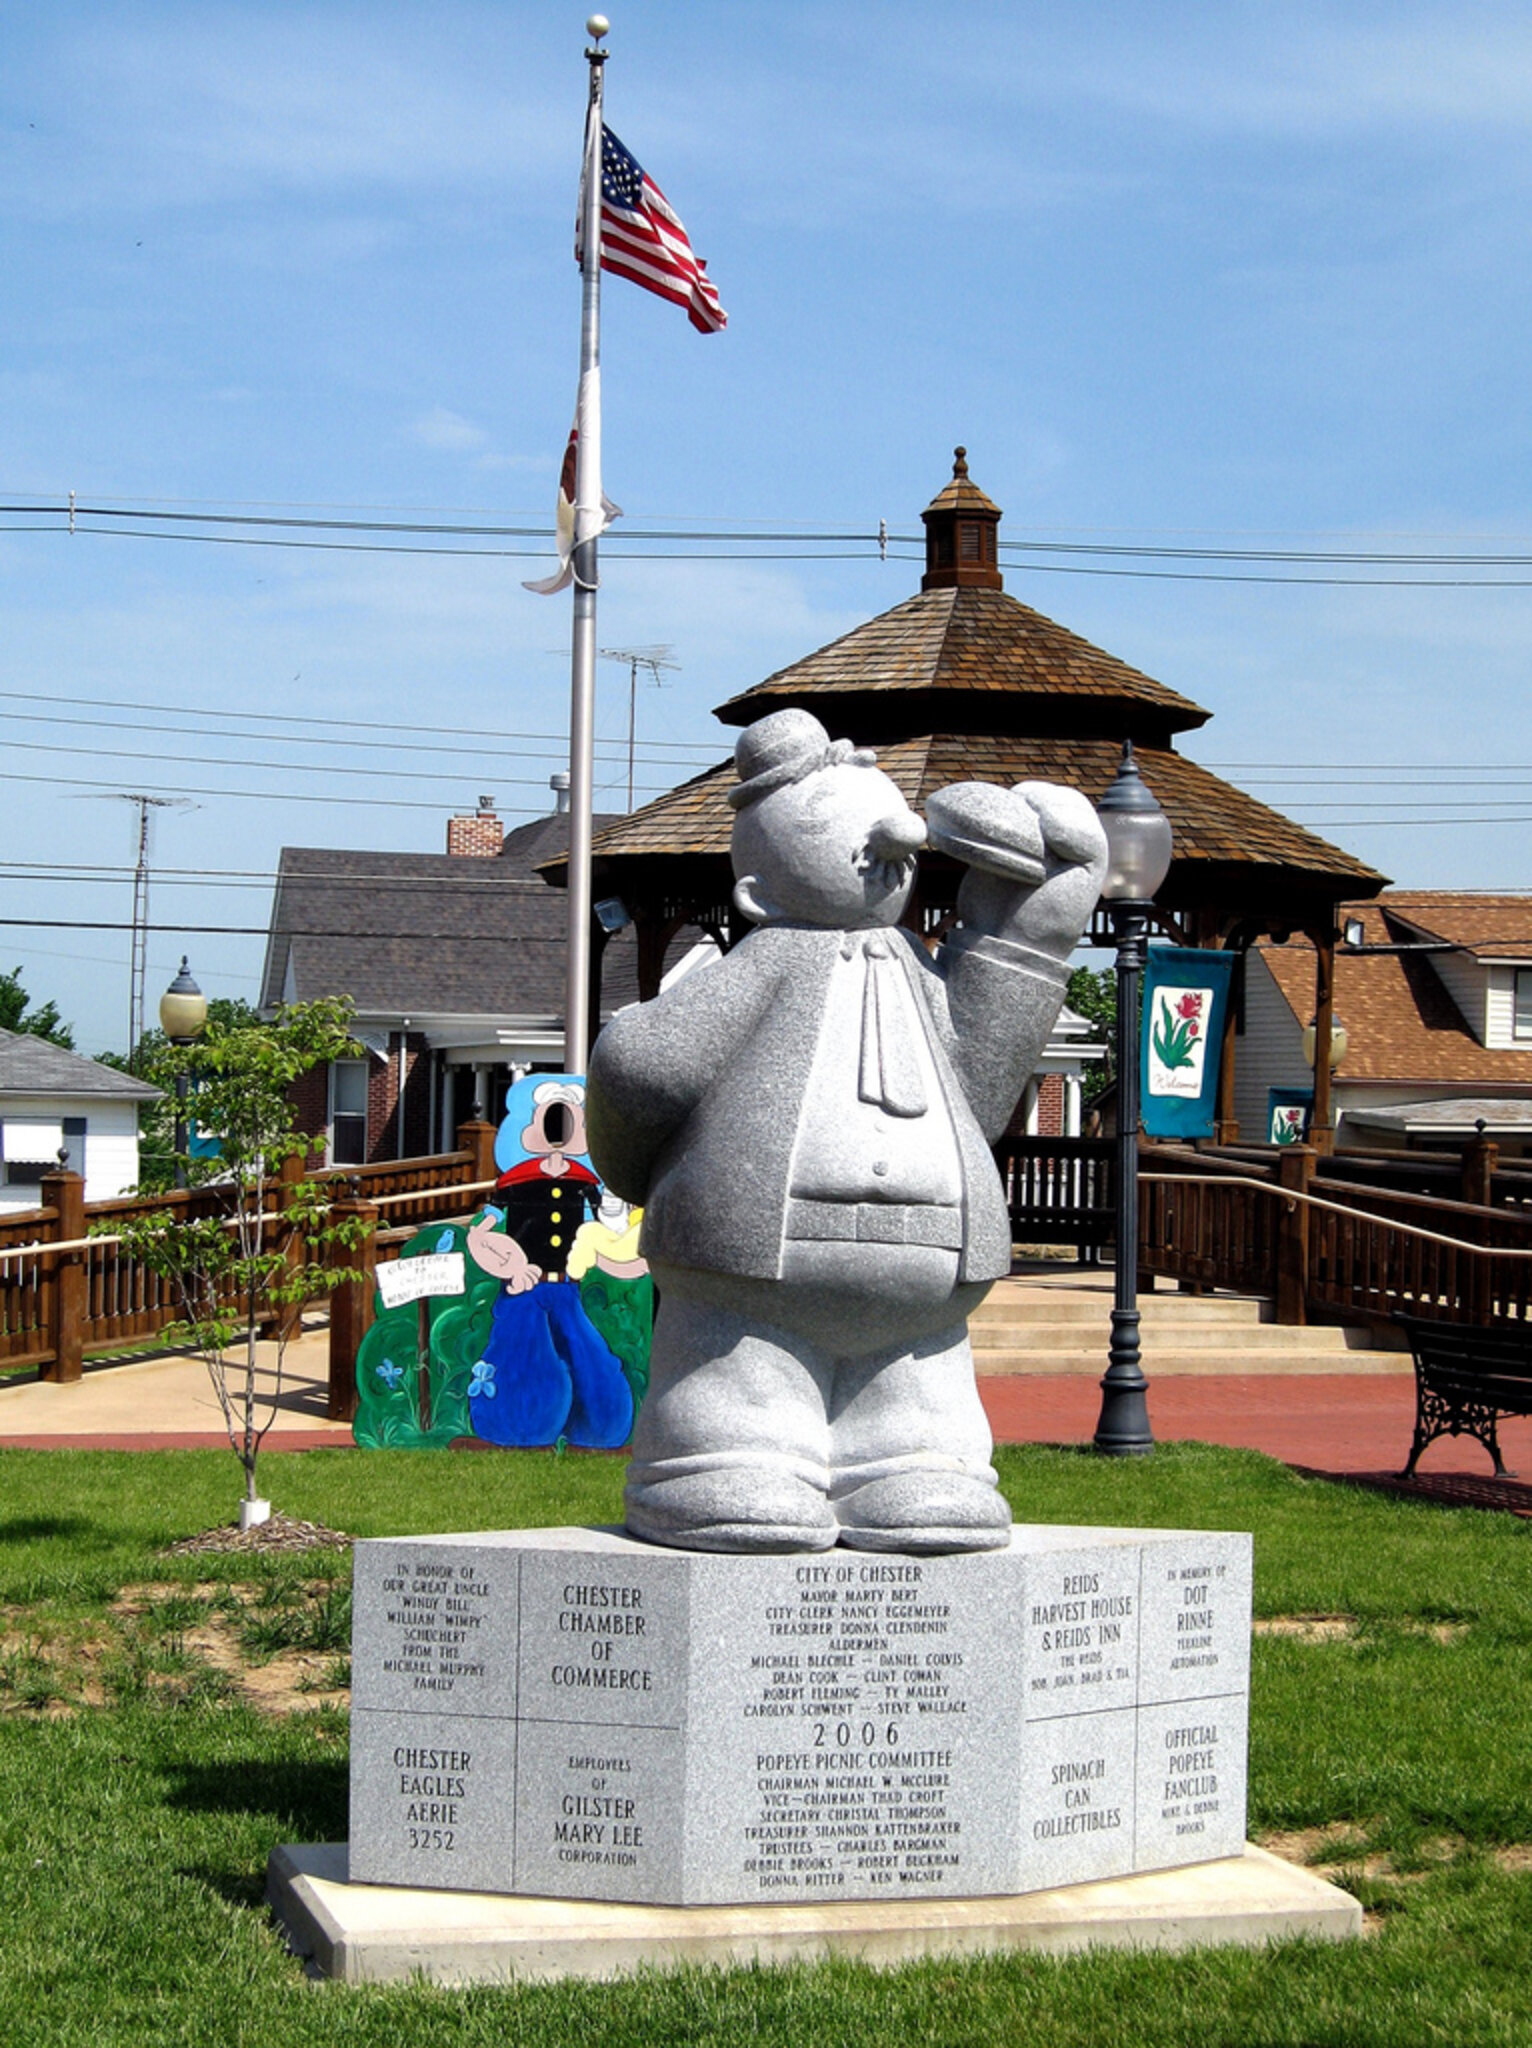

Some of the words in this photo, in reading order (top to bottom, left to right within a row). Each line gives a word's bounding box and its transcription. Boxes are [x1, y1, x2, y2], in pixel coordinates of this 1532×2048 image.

[396, 1564, 409, 1577] IN
[416, 1565, 454, 1579] HONOR
[460, 1567, 475, 1580] OF
[796, 1567, 831, 1583] CITY
[836, 1567, 854, 1582] OF
[860, 1566, 924, 1582] CHESTER
[1167, 1569, 1177, 1580] IN
[1180, 1567, 1212, 1579] MEMORY
[1216, 1564, 1226, 1577] OF
[383, 1579, 405, 1592] OUR
[412, 1580, 448, 1594] GREAT
[454, 1583, 489, 1597] UNCLE
[563, 1585, 644, 1608] CHESTER
[801, 1590, 838, 1602] MAYOR
[846, 1589, 885, 1601] MARTY
[891, 1589, 919, 1601] BERT
[1183, 1585, 1208, 1605] DOT
[387, 1611, 436, 1626] WILLIAM
[765, 1607, 793, 1620] CITY
[800, 1606, 834, 1619] CLERK
[841, 1605, 879, 1619] NANCY
[886, 1604, 951, 1618] EGGEMEYER
[1032, 1601, 1088, 1625] HARVEST
[1091, 1596, 1133, 1619] HOUSE
[559, 1611, 646, 1636] CHAMBER
[769, 1623, 834, 1636] TREASURER
[841, 1622, 880, 1635] DONNA
[1177, 1609, 1215, 1632] RINNE
[828, 1638, 890, 1651] ALDERMEN
[1042, 1631, 1052, 1652] &
[1099, 1623, 1122, 1646] INN
[402, 1644, 433, 1658] FROM
[440, 1646, 460, 1659] THE
[591, 1640, 614, 1661] OF
[383, 1660, 432, 1674] MICHAEL
[440, 1662, 485, 1677] MURPHY
[751, 1656, 801, 1669] MICHAEL
[879, 1654, 920, 1667] DANIEL
[1170, 1653, 1219, 1670] AUTOMATION
[413, 1677, 455, 1691] FAMILY
[551, 1665, 652, 1691] COMMERCE
[773, 1671, 803, 1684] DEAN
[809, 1671, 839, 1684] COOK
[864, 1670, 897, 1683] CLINT
[763, 1688, 805, 1701] ROBERT
[811, 1687, 861, 1700] FLEMING
[885, 1686, 900, 1699] TY
[906, 1685, 950, 1698] MALLEY
[743, 1703, 795, 1717] CAROLYN
[801, 1703, 854, 1716] SCHWENT
[877, 1702, 912, 1715] STEVE
[918, 1701, 969, 1714] WALLACE
[1165, 1724, 1218, 1749] OFFICIAL
[393, 1747, 471, 1772] CHESTER
[568, 1756, 631, 1772] EMPLOYEES
[757, 1754, 810, 1771] POPEYE
[816, 1752, 865, 1770] PICNIC
[869, 1751, 954, 1768] COMMITTEE
[1169, 1750, 1215, 1774] POPEYE
[1051, 1759, 1105, 1785] SPINACH
[401, 1774, 465, 1798] EAGLES
[591, 1778, 607, 1790] OF
[757, 1778, 820, 1791] CHAIRMAN
[826, 1776, 875, 1789] MICHAEL
[1165, 1775, 1218, 1800] FANCLUB
[872, 1791, 903, 1804] THAD
[909, 1789, 945, 1803] CROFT
[1065, 1787, 1091, 1809] CAN
[407, 1802, 458, 1824] AERIE
[562, 1794, 635, 1819] GILSTER
[760, 1810, 820, 1823] SECRETARY
[828, 1808, 881, 1822] CHRISTAL
[888, 1806, 947, 1820] THOMPSON
[1184, 1803, 1191, 1816] &
[1033, 1807, 1121, 1840] COLLECTIBLES
[408, 1828, 455, 1851] 3252
[554, 1821, 605, 1844] MARY
[613, 1825, 644, 1848] LEE
[744, 1826, 809, 1840] TREASURER
[815, 1825, 869, 1838] SHANNON
[759, 1842, 813, 1855] TRUSTEES
[837, 1840, 887, 1853] CHARLES
[559, 1849, 637, 1867] CORPORATION
[744, 1859, 785, 1872] DEBBIE
[790, 1857, 834, 1870] BROOKS
[857, 1855, 899, 1868] ROBERT
[759, 1875, 798, 1888] DONNA
[805, 1873, 845, 1886] RITTER
[870, 1872, 892, 1884] KEN
[900, 1870, 944, 1883] WAGNER
